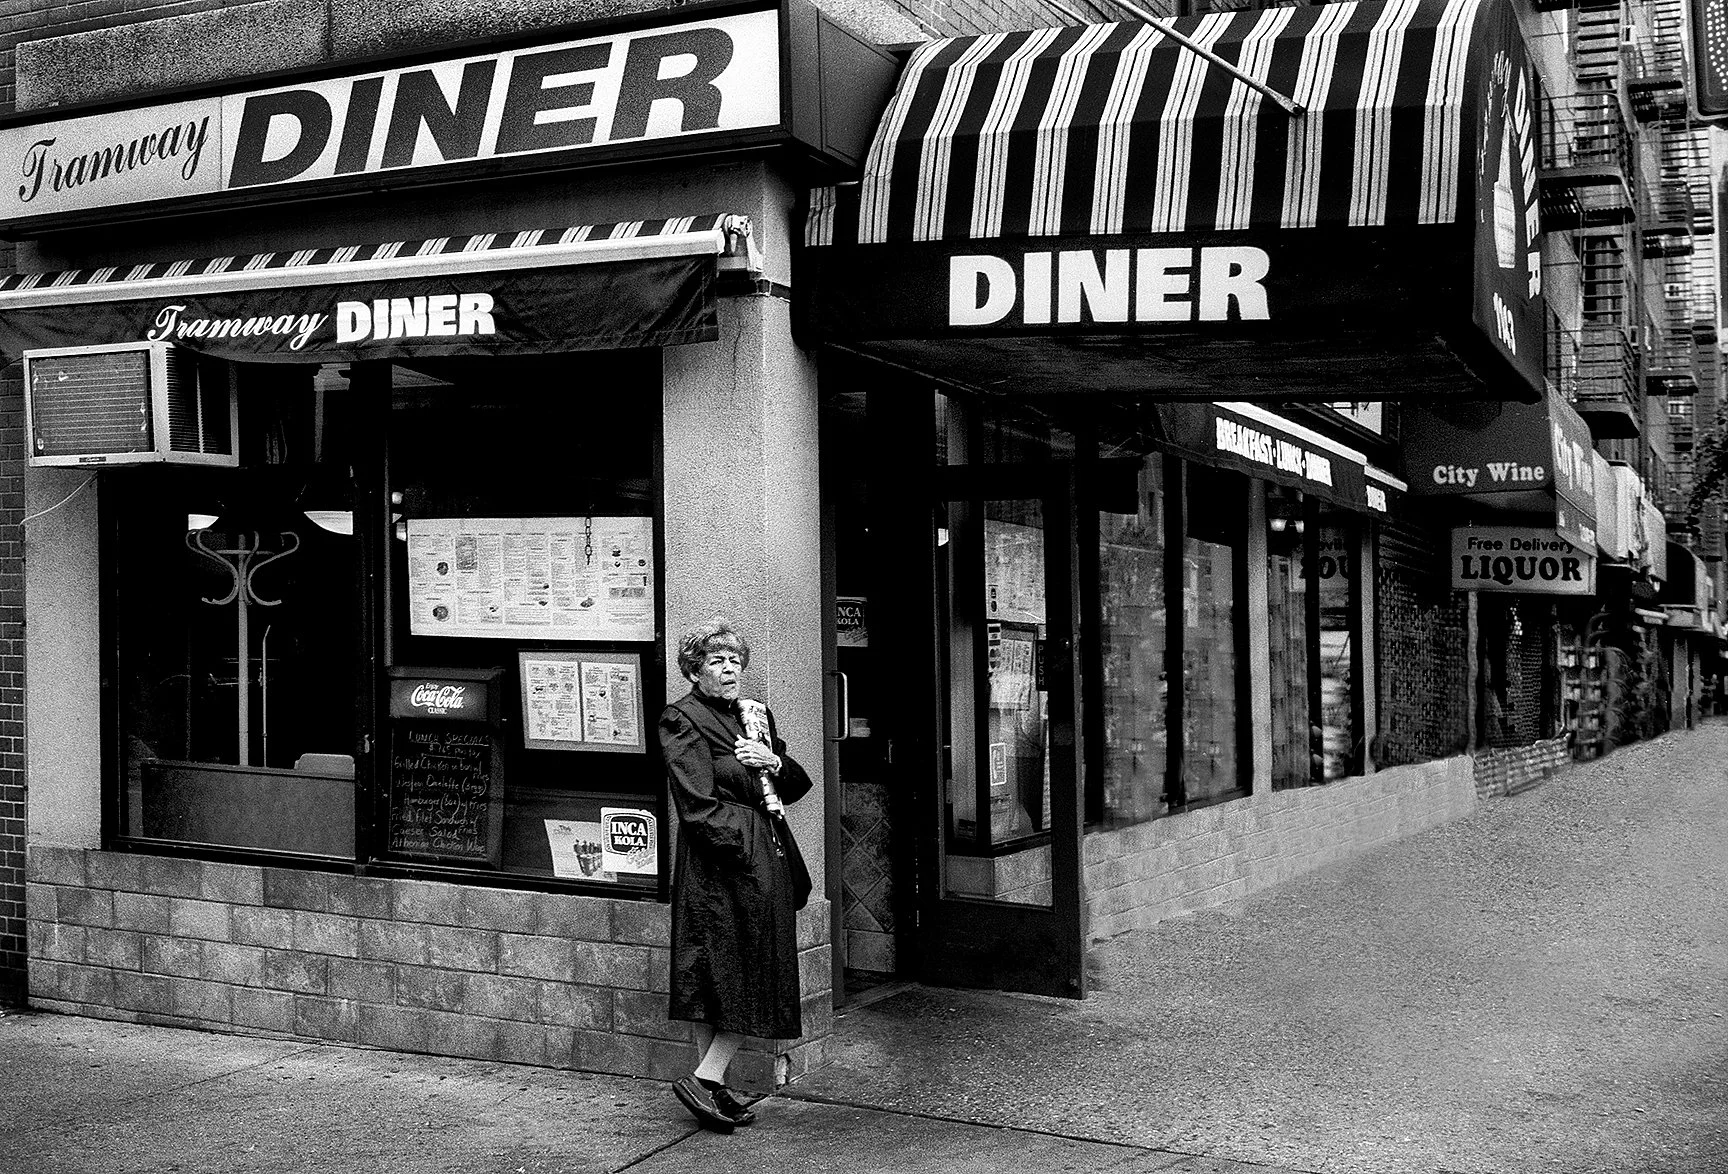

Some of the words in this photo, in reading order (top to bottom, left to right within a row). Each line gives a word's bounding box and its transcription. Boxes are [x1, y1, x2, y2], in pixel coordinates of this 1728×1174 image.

[18, 114, 210, 203] Tramway
[228, 28, 734, 189] DINER
[1514, 66, 1540, 299] DINER
[949, 246, 1270, 326] DINER
[146, 304, 329, 351] Tramway
[336, 293, 497, 344] DINER
[1433, 465, 1479, 488] City
[1486, 462, 1546, 482] Wine
[1468, 536, 1504, 551] Free
[1510, 537, 1575, 555] Delivery
[1461, 555, 1583, 586] LIQUOR
[837, 606, 862, 618] NCA
[1037, 644, 1045, 686] PUSH
[411, 684, 466, 709] Coca-Cola
[611, 821, 648, 837] INCA
[613, 836, 647, 847] KOLA
